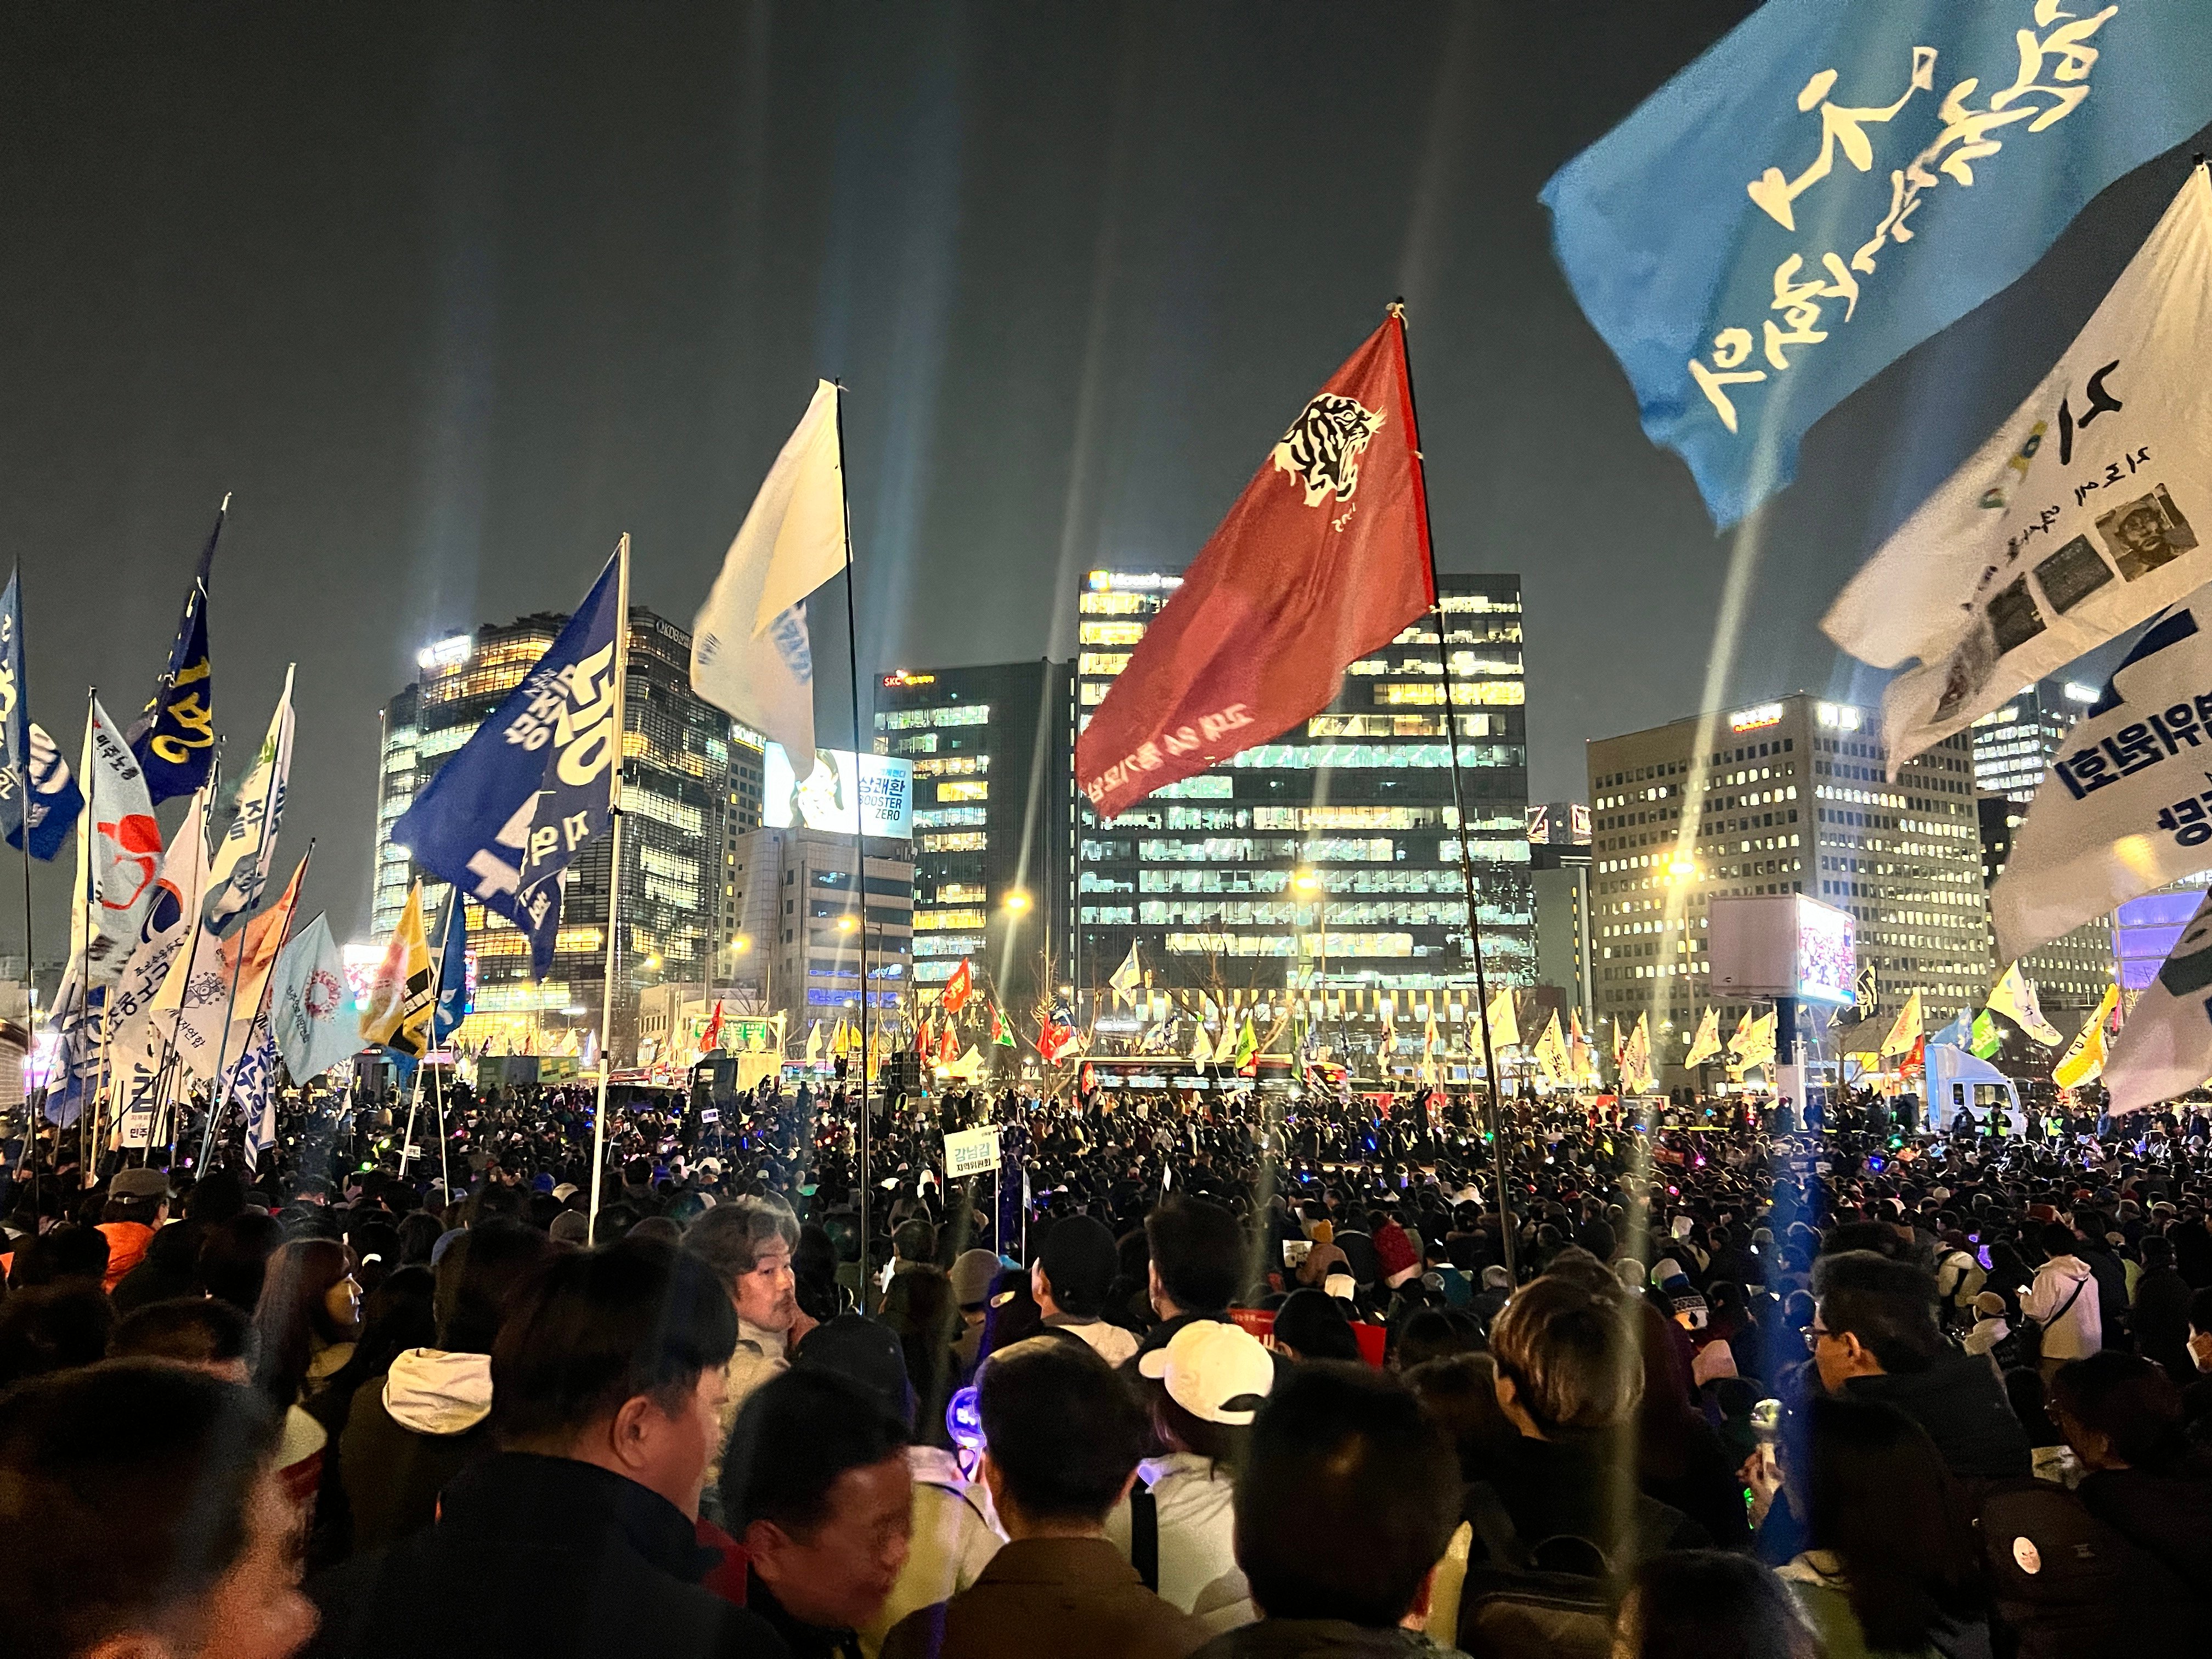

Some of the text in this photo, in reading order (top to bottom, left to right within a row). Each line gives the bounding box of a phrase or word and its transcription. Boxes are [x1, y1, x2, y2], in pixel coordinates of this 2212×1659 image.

[884, 676, 902, 687] SKC
[860, 777, 905, 797] 상쾌환
[860, 795, 902, 809] BOOSTER
[876, 809, 900, 821] ZERO
[957, 1158, 991, 1172] 지역위원회
